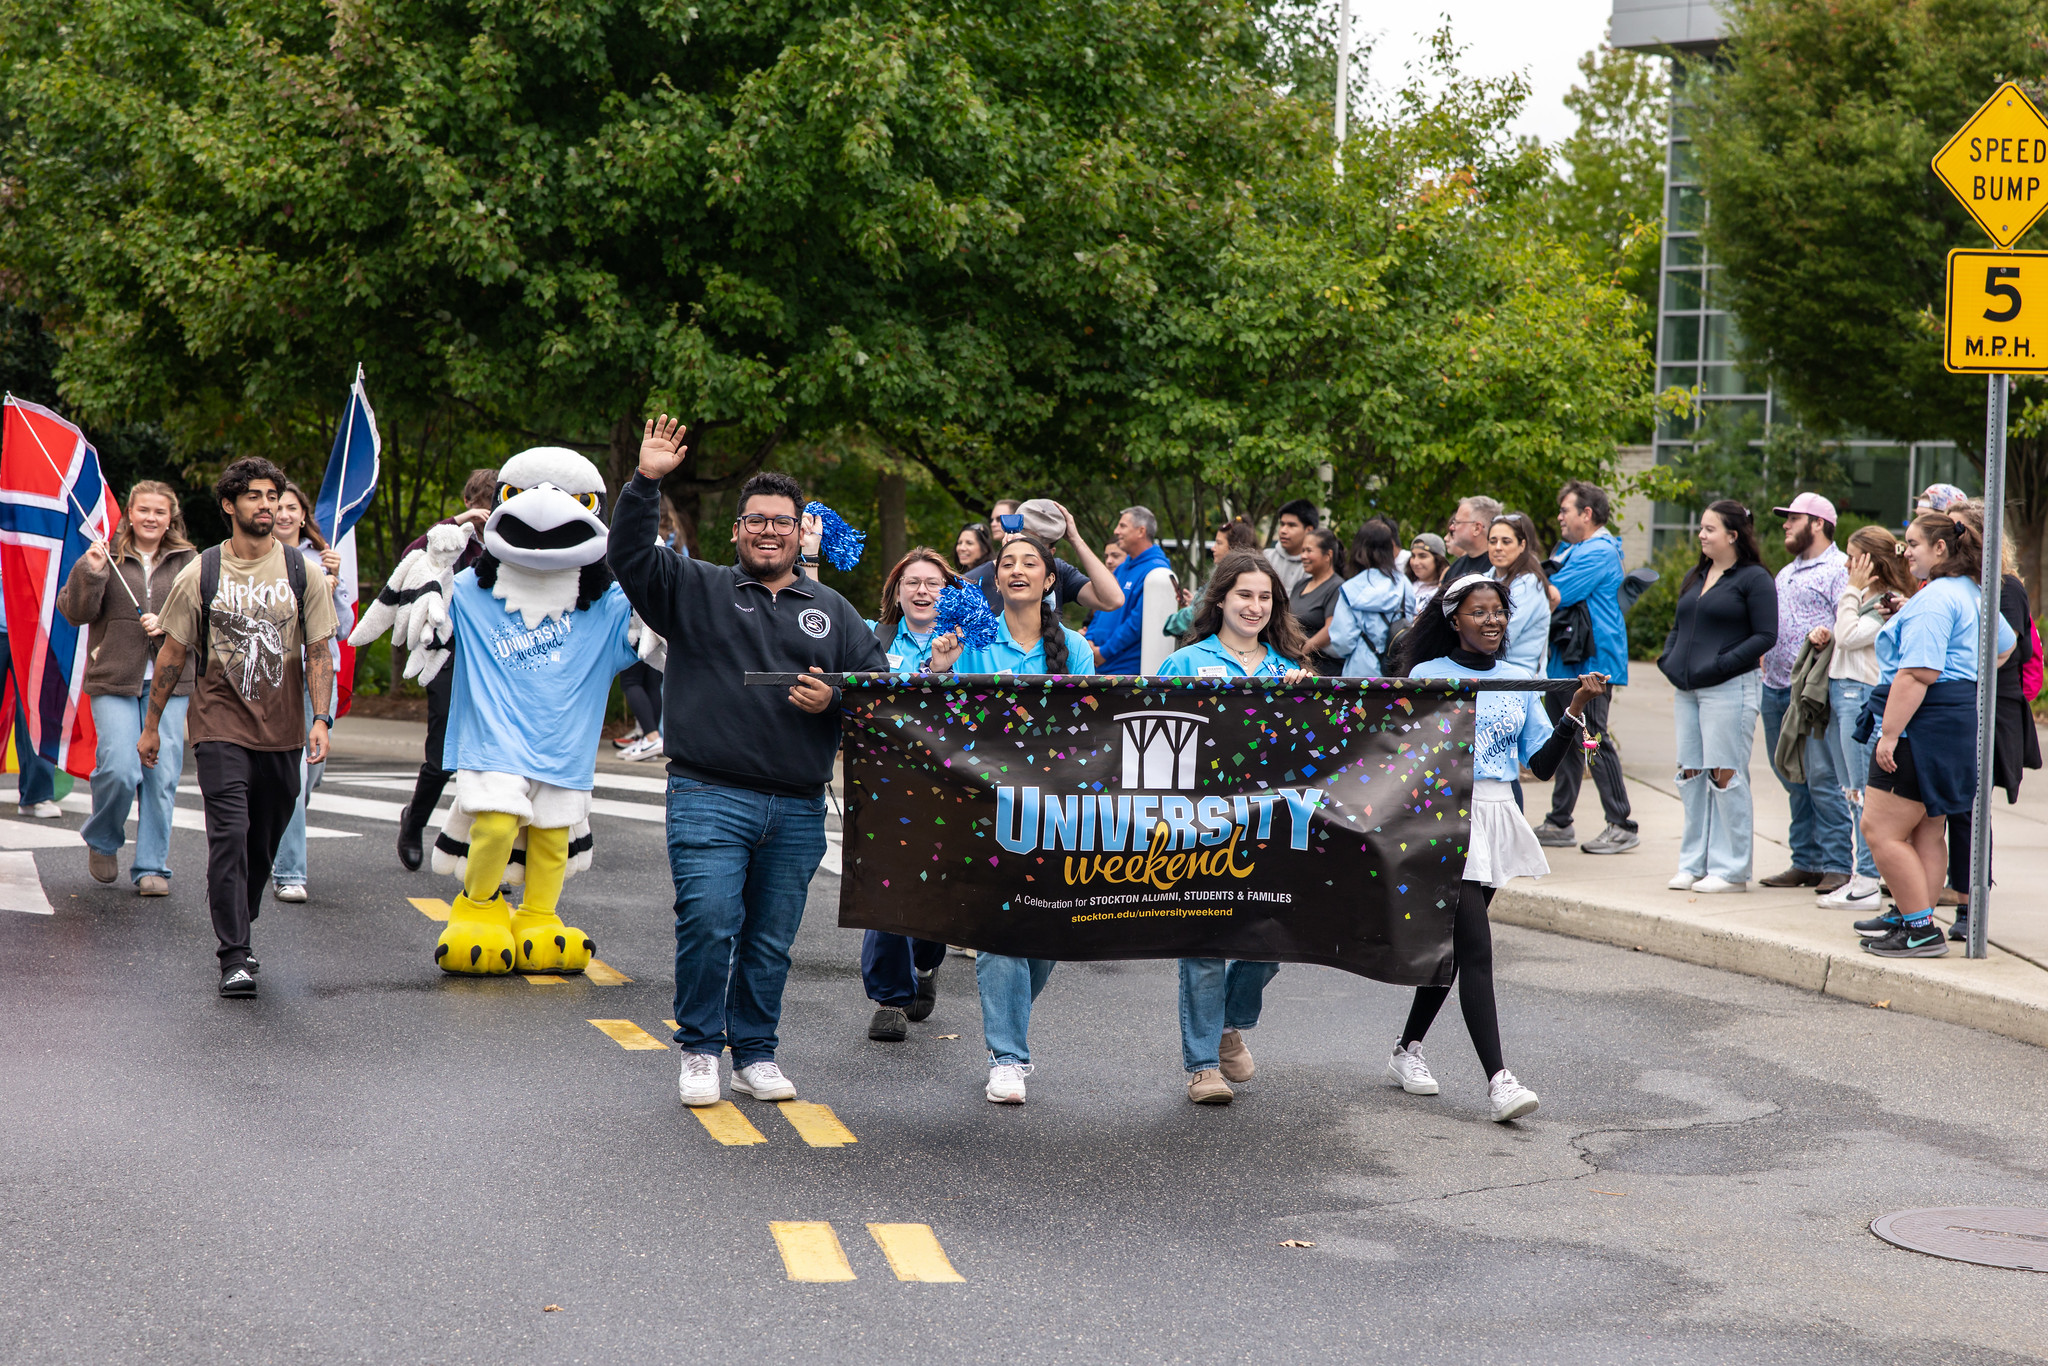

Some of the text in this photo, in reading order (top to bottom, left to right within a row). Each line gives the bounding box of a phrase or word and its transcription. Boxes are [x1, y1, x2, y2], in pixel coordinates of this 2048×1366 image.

[1969, 137, 2047, 163] SPEED
[1973, 175, 2040, 201] BUMP
[1982, 266, 2022, 322] 5
[1965, 336, 2035, 358] M.P.H.
[496, 614, 572, 658] UNIVERSITY
[517, 632, 563, 661] weekend
[1474, 705, 1526, 757] NIVERSIT
[995, 786, 1324, 855] UNIVERSITY
[1063, 821, 1255, 890] weekend
[1014, 891, 1292, 909] A Celebration for STOCKTON ALUMNI, STUDENTS & FAMILIES
[1071, 908, 1233, 923] stockton.edu/universityweekend
